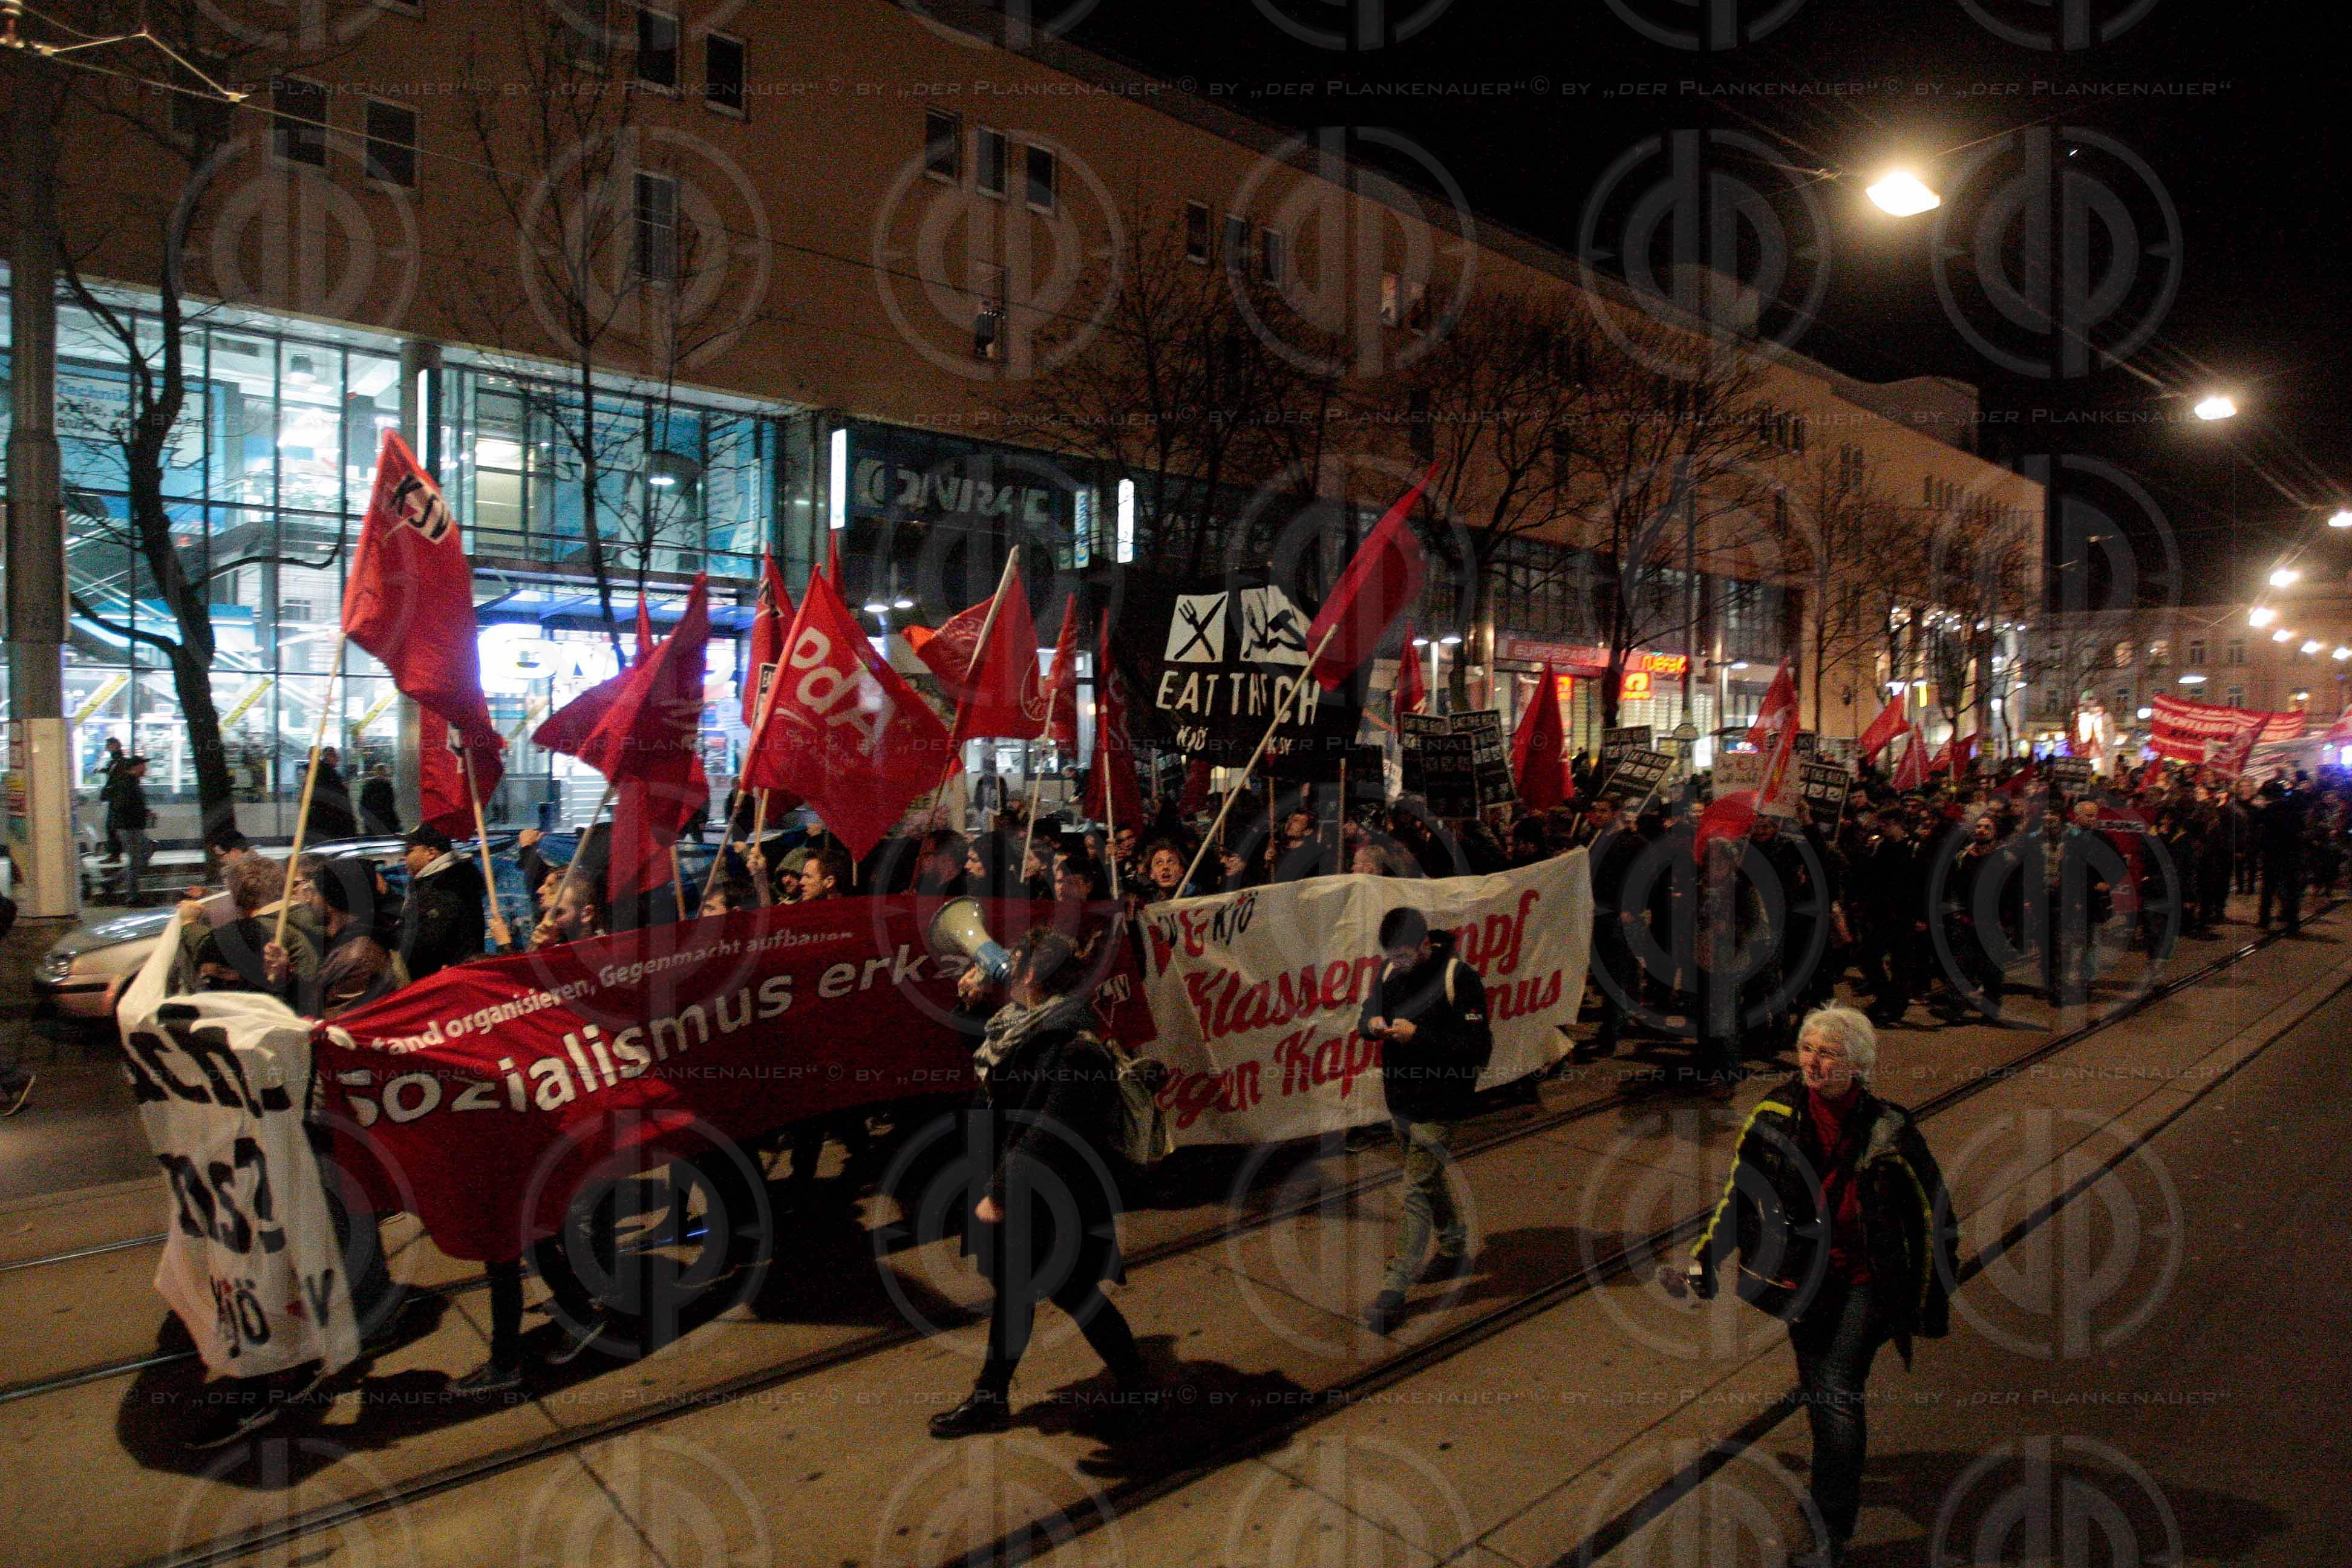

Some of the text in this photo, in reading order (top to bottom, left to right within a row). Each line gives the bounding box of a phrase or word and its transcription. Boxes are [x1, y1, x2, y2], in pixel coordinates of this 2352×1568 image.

[789, 626, 897, 763] PdA
[1156, 670, 1220, 716] EAT
[1183, 889, 1540, 1043] Klassenmpf
[1212, 890, 1259, 946] KJÖ
[445, 979, 598, 1038] organisieren,
[598, 938, 742, 988] Gegenmacht
[745, 928, 853, 953] aufbauen
[338, 974, 793, 1127] Sozialismus
